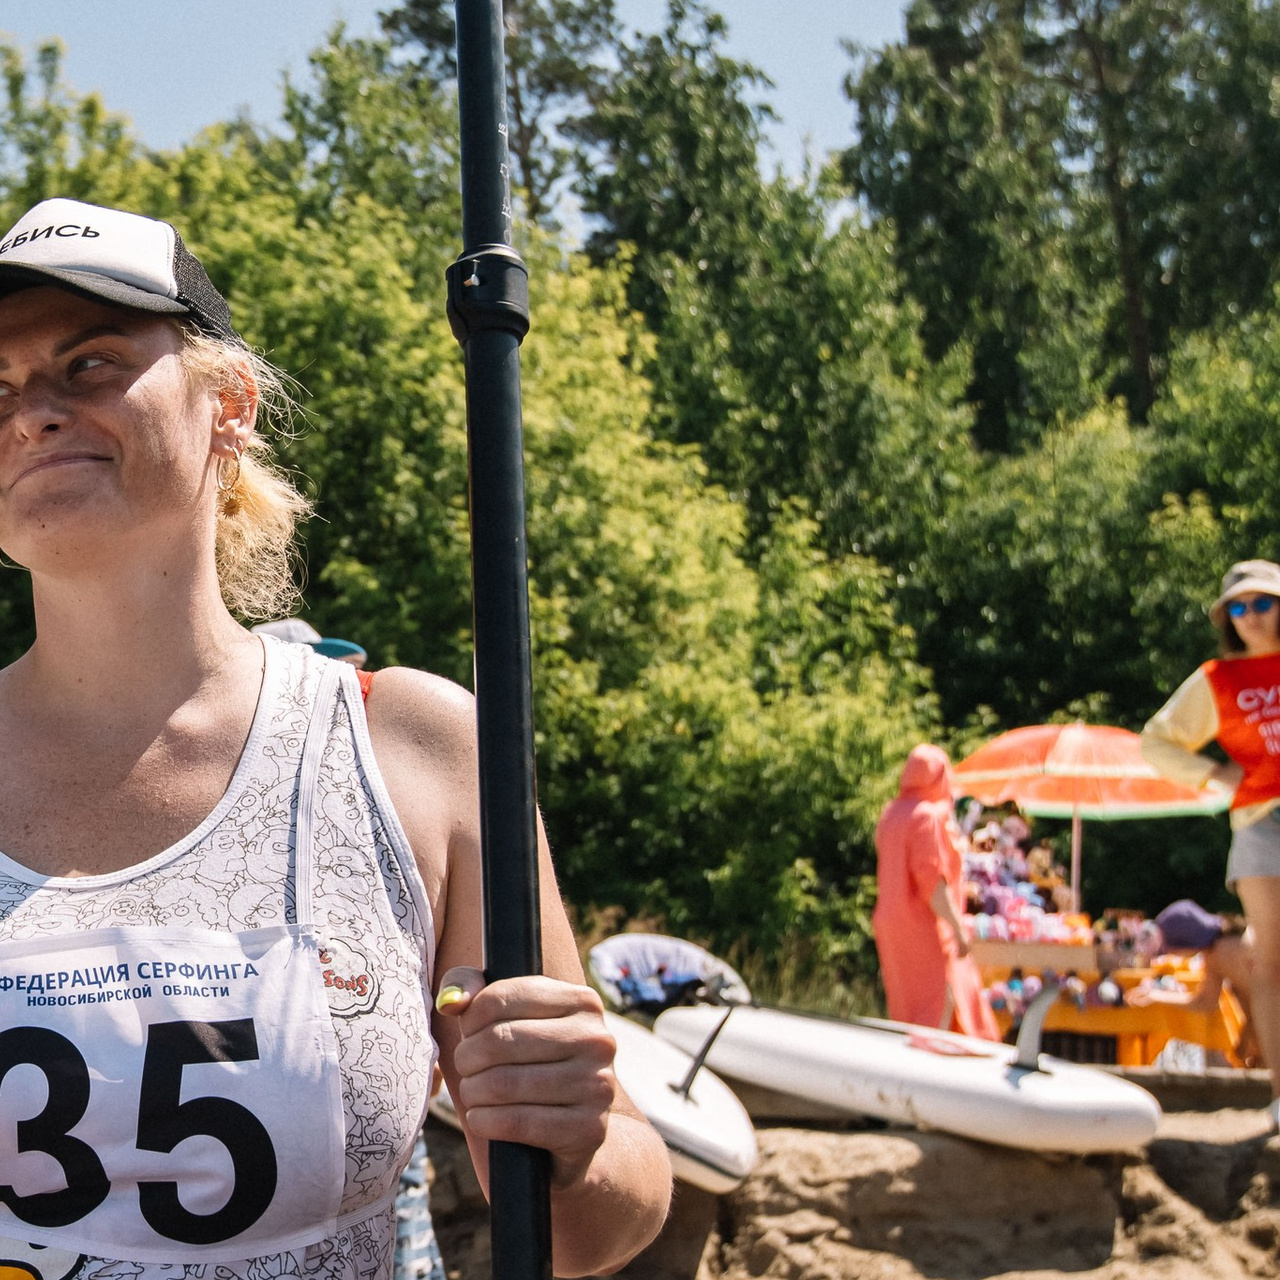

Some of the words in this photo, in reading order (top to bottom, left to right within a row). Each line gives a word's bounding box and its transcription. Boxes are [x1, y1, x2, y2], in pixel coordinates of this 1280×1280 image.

[137, 961, 260, 981] СЕРФИНГА
[322, 969, 369, 997] SONS
[27, 984, 152, 1007] НОВОСИБИРСКОЙ
[163, 984, 230, 998] ОБЛАСТИ
